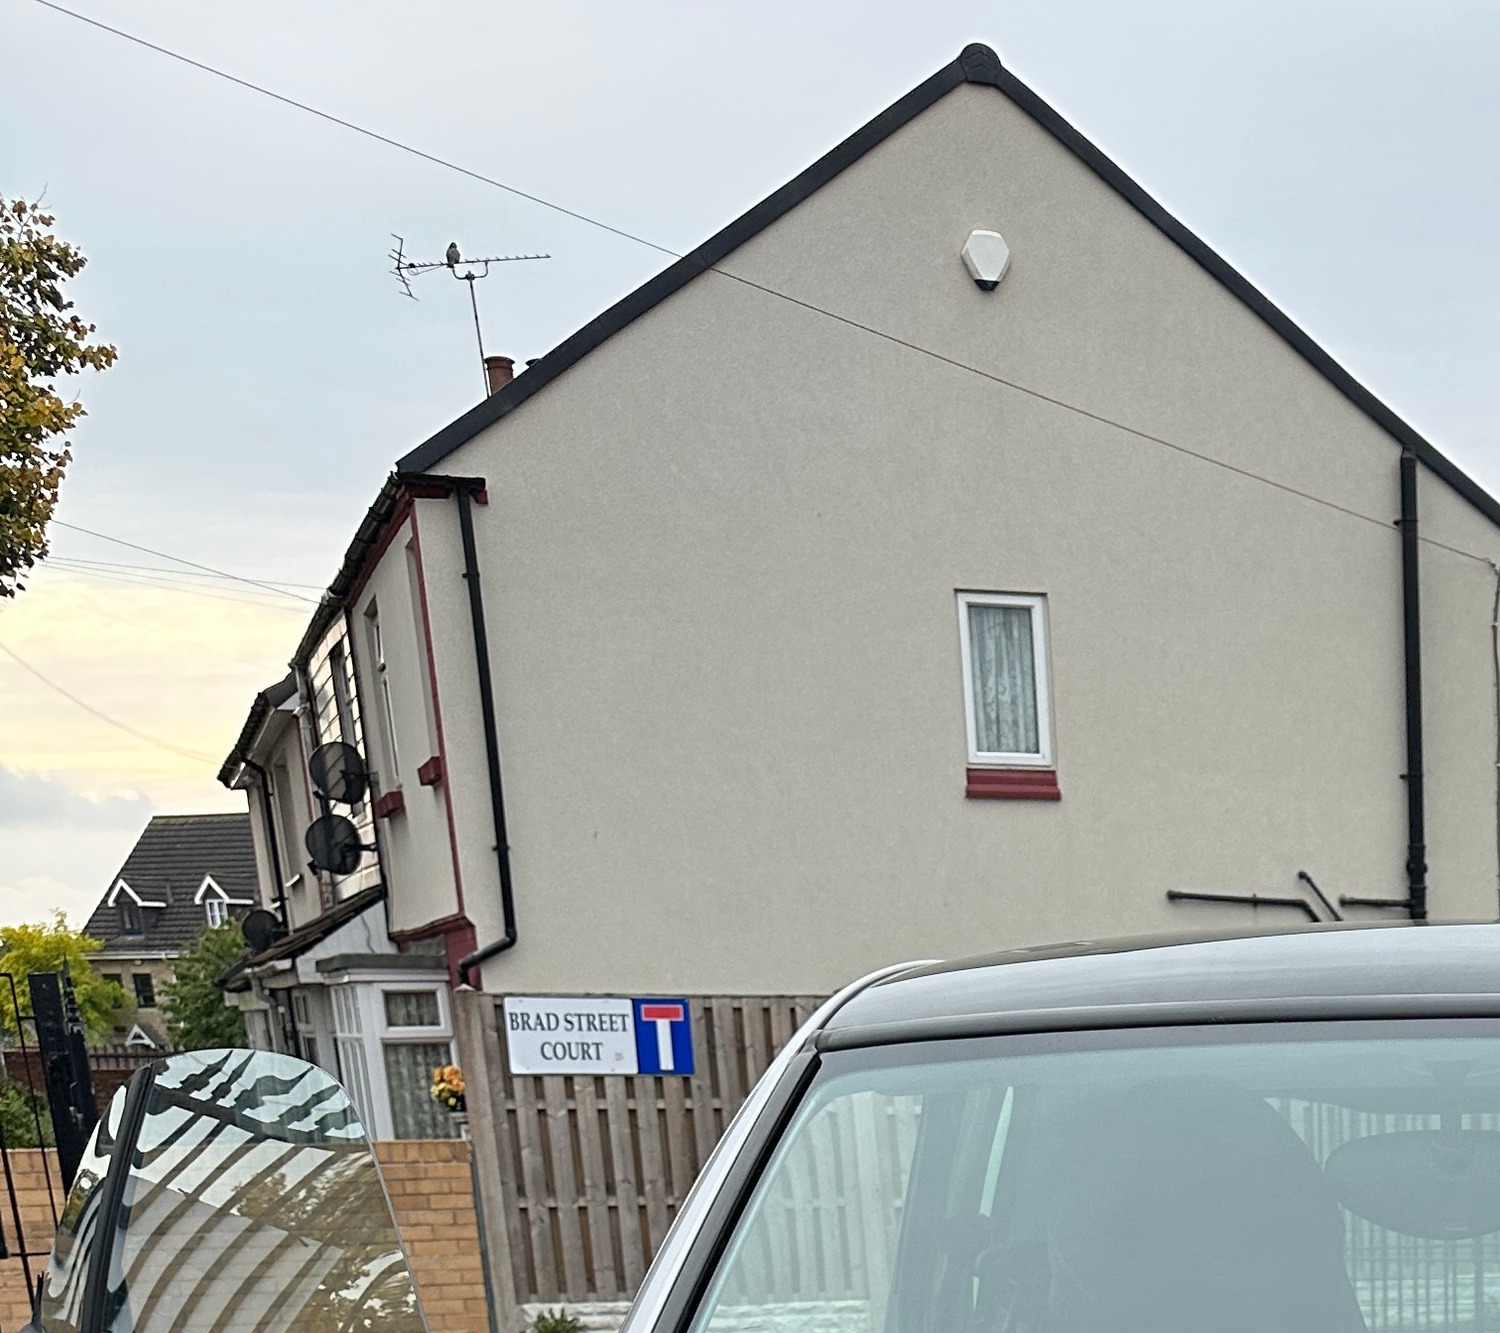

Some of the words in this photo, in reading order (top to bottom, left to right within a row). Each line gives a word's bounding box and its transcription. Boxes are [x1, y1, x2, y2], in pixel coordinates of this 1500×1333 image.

[508, 1011, 560, 1032] BRAD
[563, 1012, 630, 1033] STREET
[540, 1041, 604, 1061] COURT
